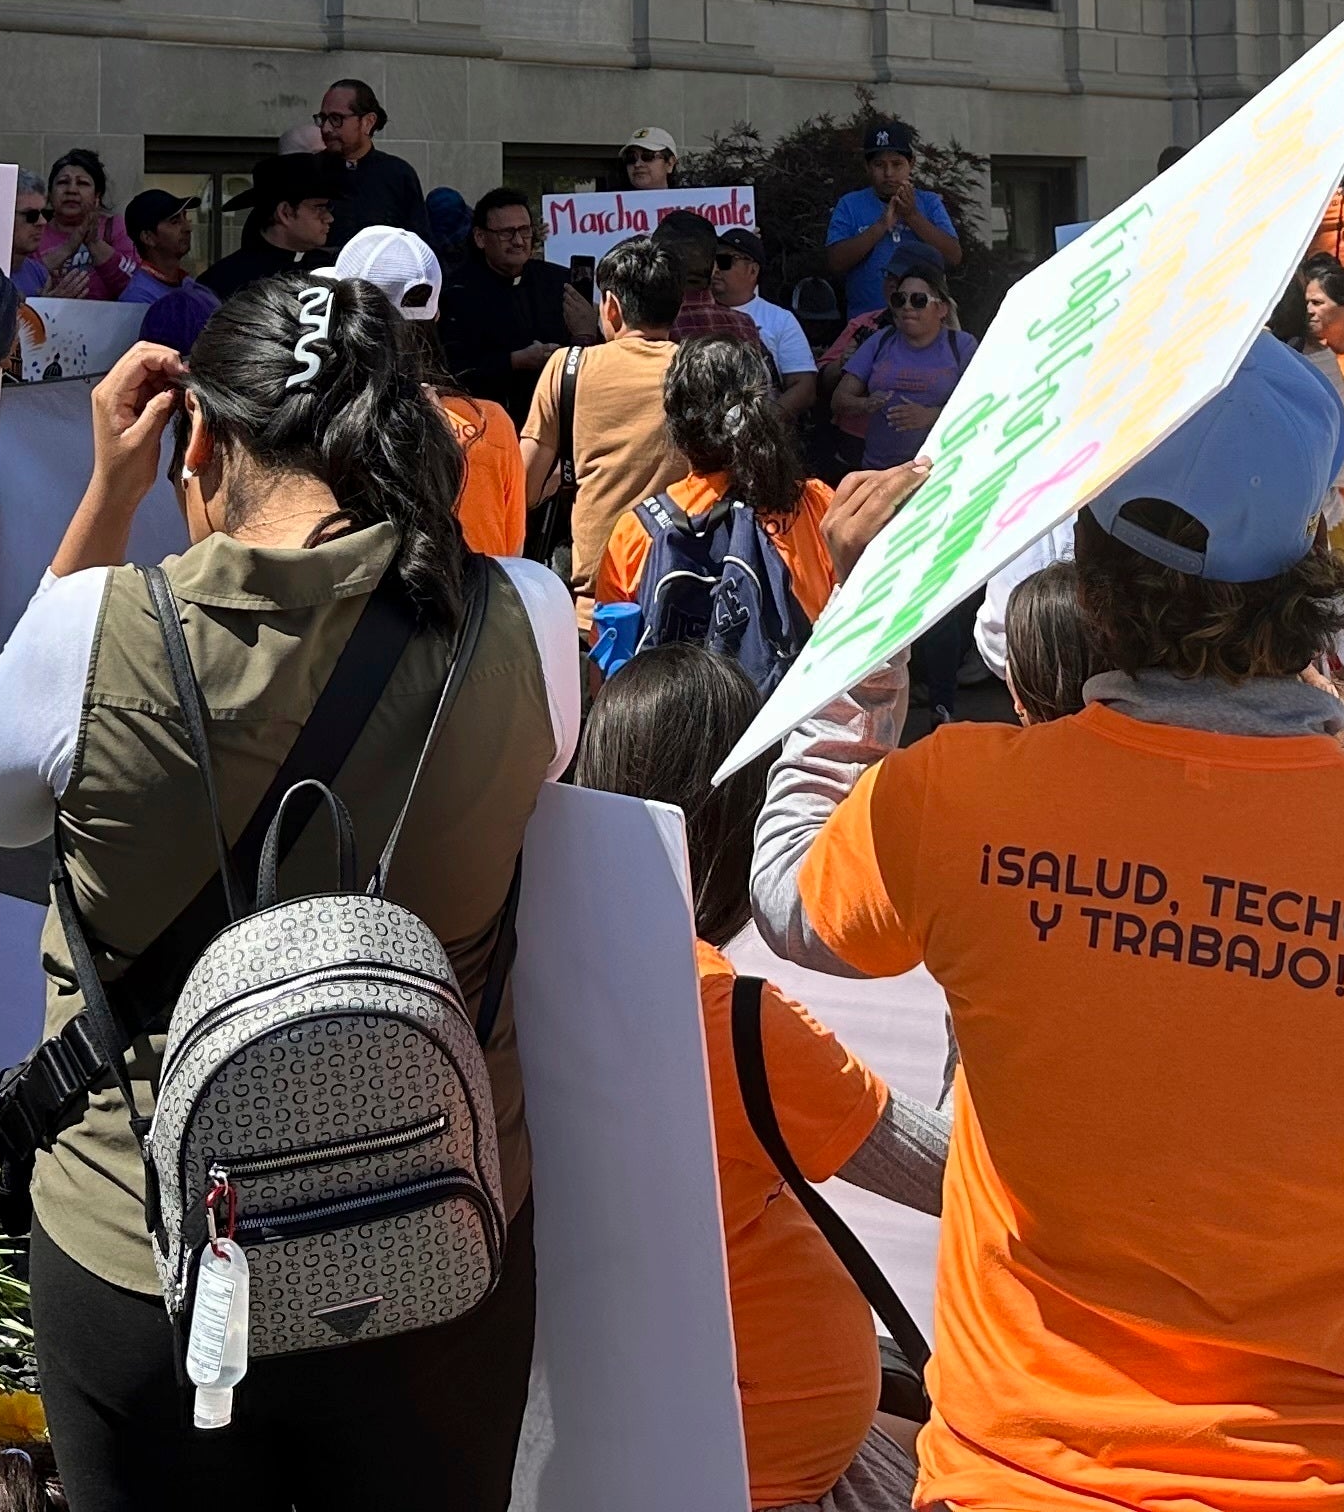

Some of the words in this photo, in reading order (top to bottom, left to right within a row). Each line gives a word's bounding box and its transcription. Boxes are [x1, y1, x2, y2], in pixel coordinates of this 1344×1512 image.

[549, 194, 650, 235] Marcha
[1028, 203, 1154, 374] Fight
[566, 346, 582, 375] SON
[993, 341, 1096, 455] for
[844, 417, 1062, 681] human
[980, 844, 1179, 916] ¡SALUD,
[1029, 900, 1063, 942] Y
